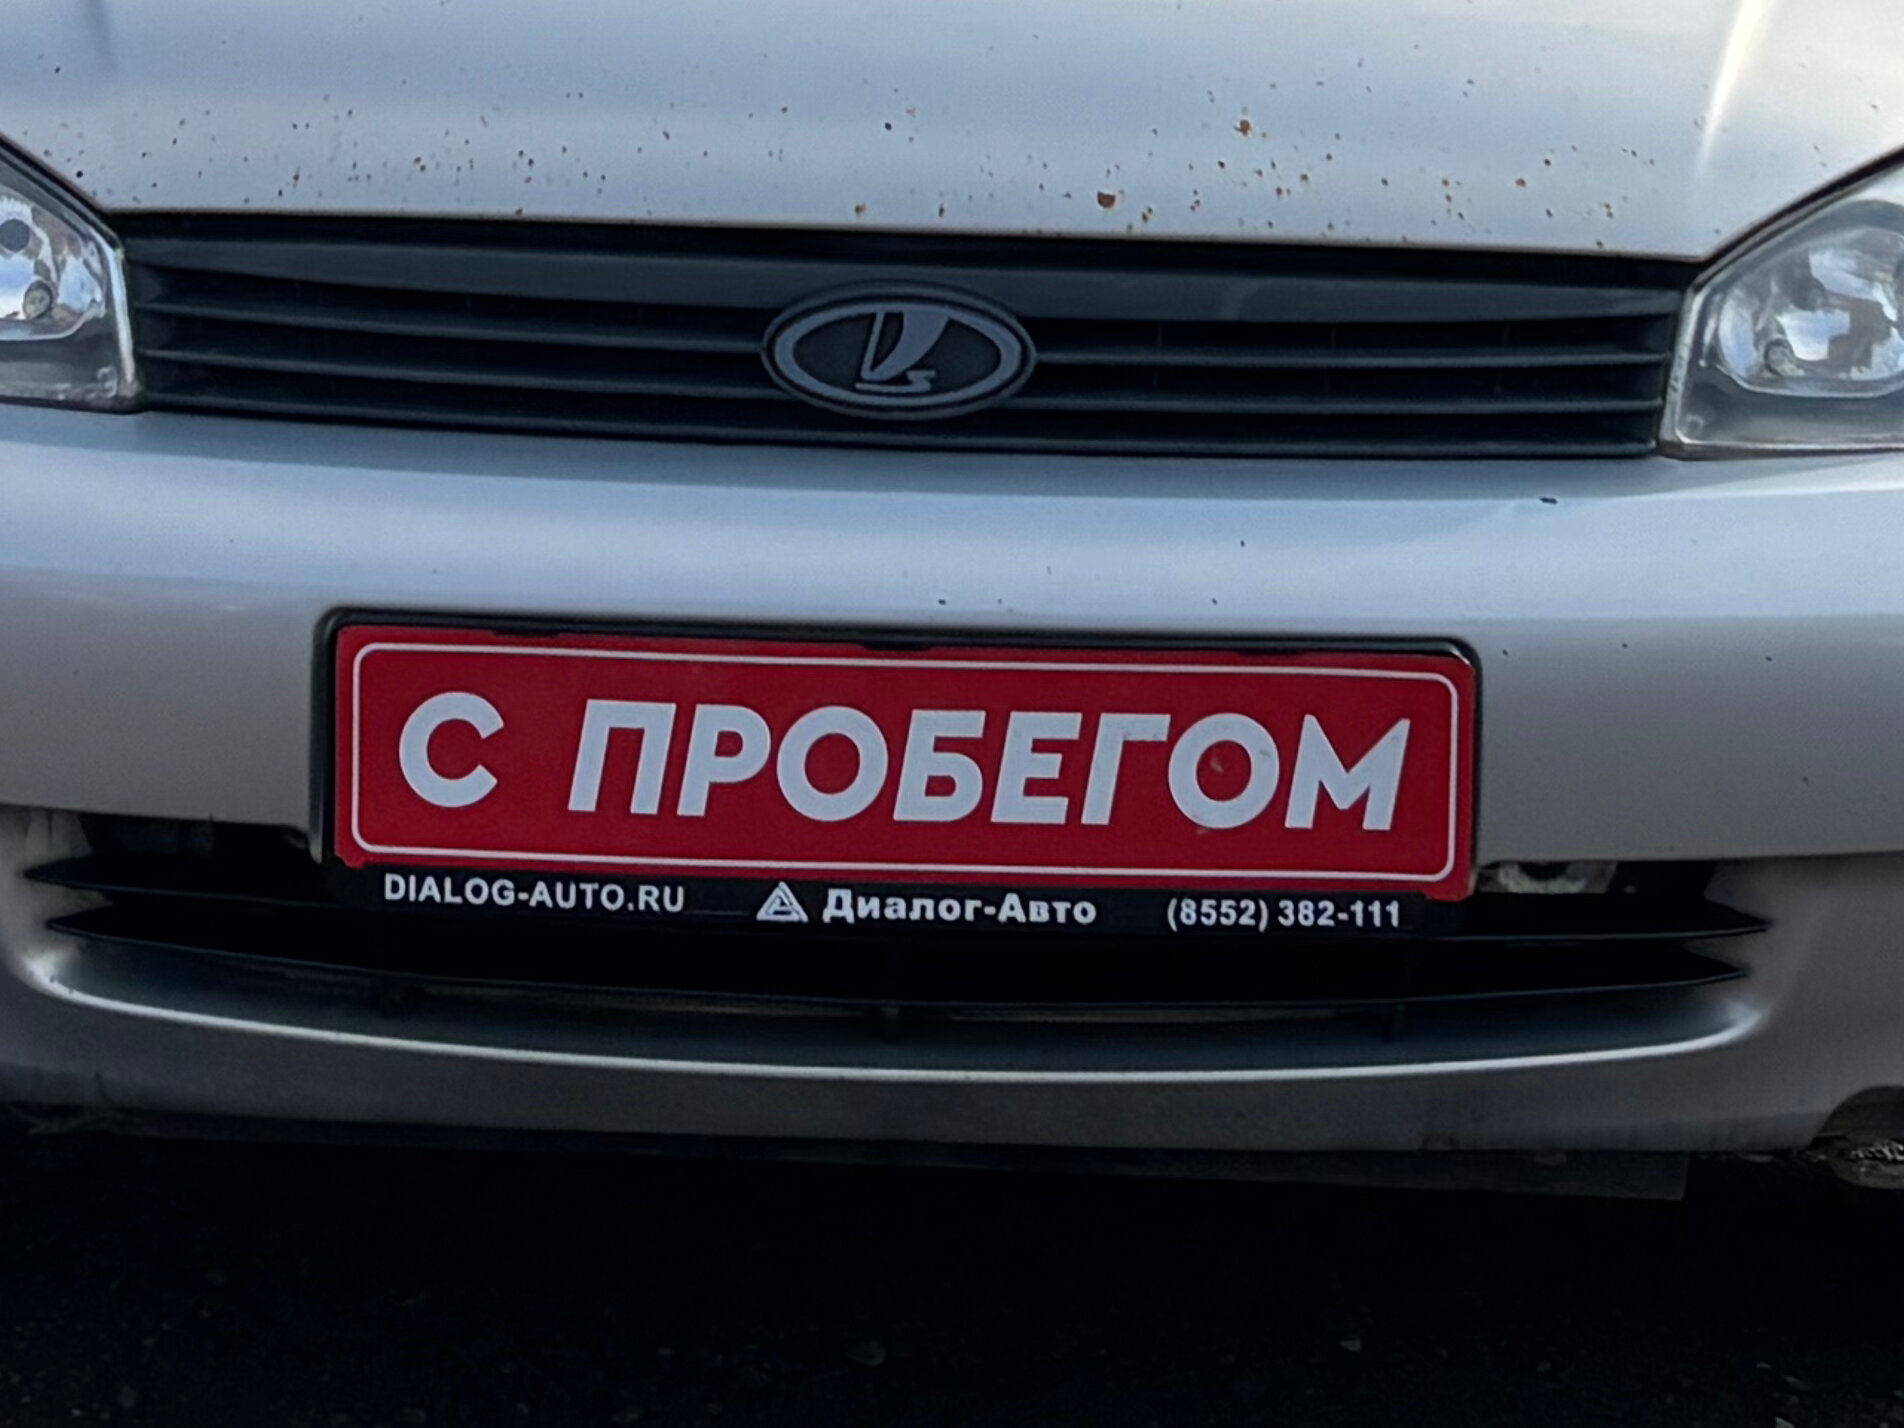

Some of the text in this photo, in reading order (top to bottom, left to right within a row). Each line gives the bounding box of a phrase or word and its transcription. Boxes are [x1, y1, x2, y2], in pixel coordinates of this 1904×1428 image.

[399, 691, 1410, 831] С ПРОБЕГОМ
[384, 873, 686, 912] DIALOG-AUTO.RU
[823, 888, 1096, 925] Диалог-Авто
[1167, 897, 1400, 931] (8552) 382-111
